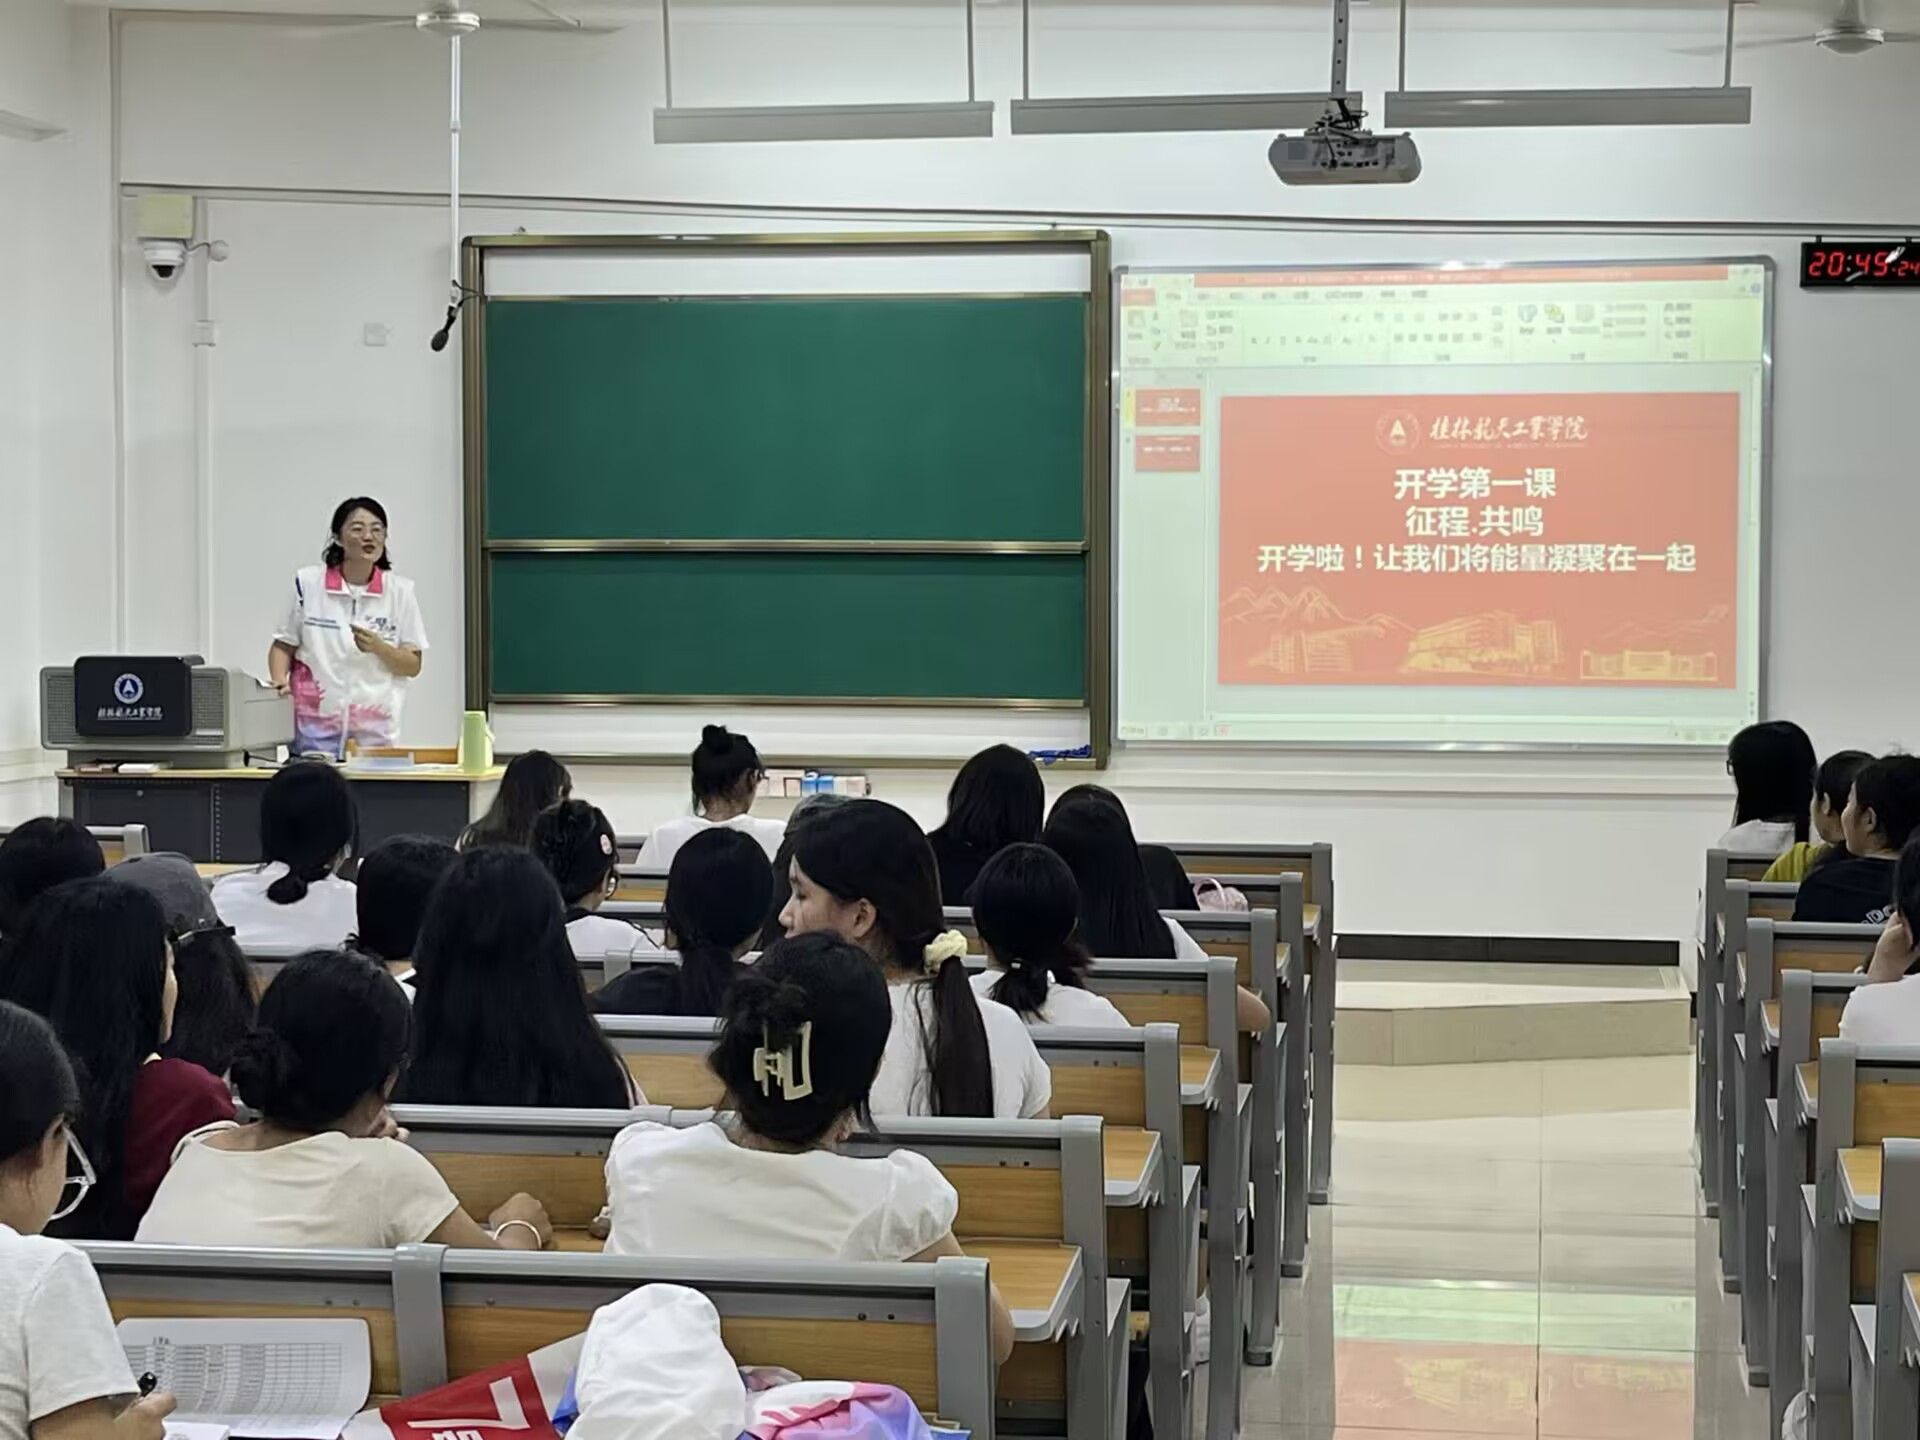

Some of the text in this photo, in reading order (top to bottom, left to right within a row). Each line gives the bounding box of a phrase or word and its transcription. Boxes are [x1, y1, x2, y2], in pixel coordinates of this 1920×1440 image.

[1393, 467, 1556, 500] 开学第一课
[1405, 505, 1544, 537] 征程.共鸣
